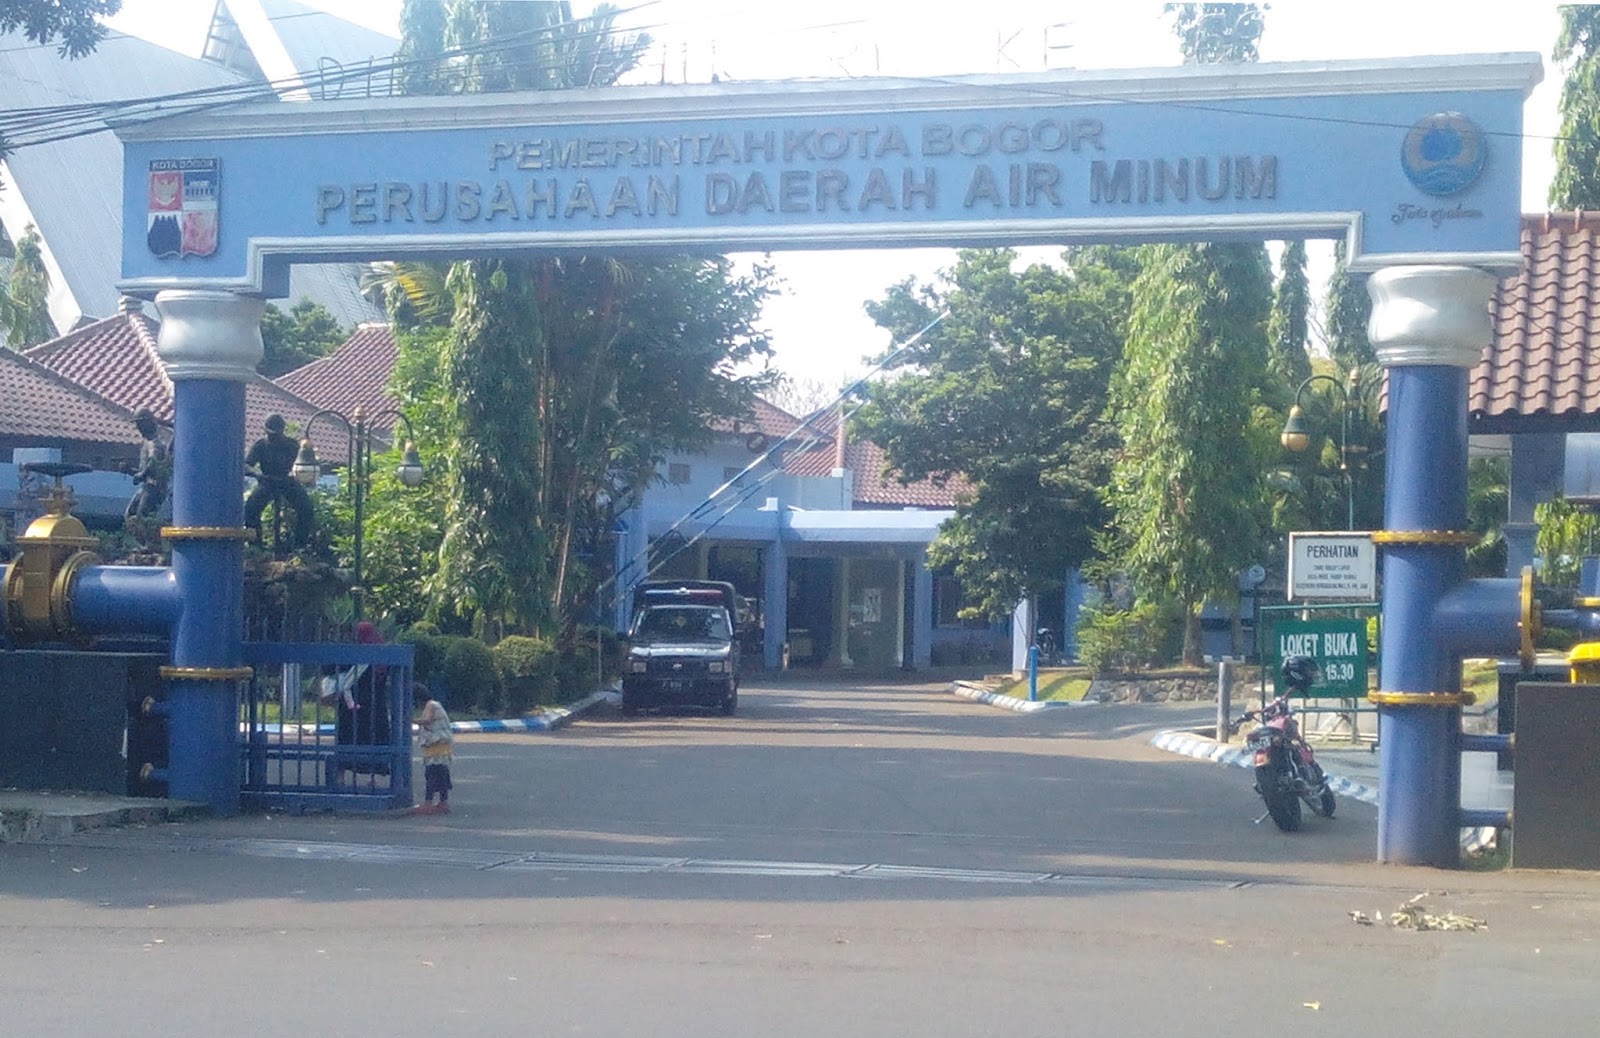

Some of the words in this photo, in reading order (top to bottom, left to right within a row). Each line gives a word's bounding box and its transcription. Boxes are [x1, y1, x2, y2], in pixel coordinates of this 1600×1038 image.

[489, 128, 775, 171] PEMERINTAH
[783, 125, 910, 161] KOTA
[921, 118, 1106, 157] BOGOR
[152, 160, 178, 170] KOTA
[316, 173, 679, 226] PERUSAHAAN
[705, 166, 936, 215] DAERAH
[963, 160, 1062, 209] AIR
[1090, 154, 1278, 204] MINUM
[1306, 545, 1359, 559] PERHATIAN
[1280, 633, 1319, 657] LOKET
[1324, 632, 1358, 656] BUKA
[1325, 663, 1354, 682] 15.30
